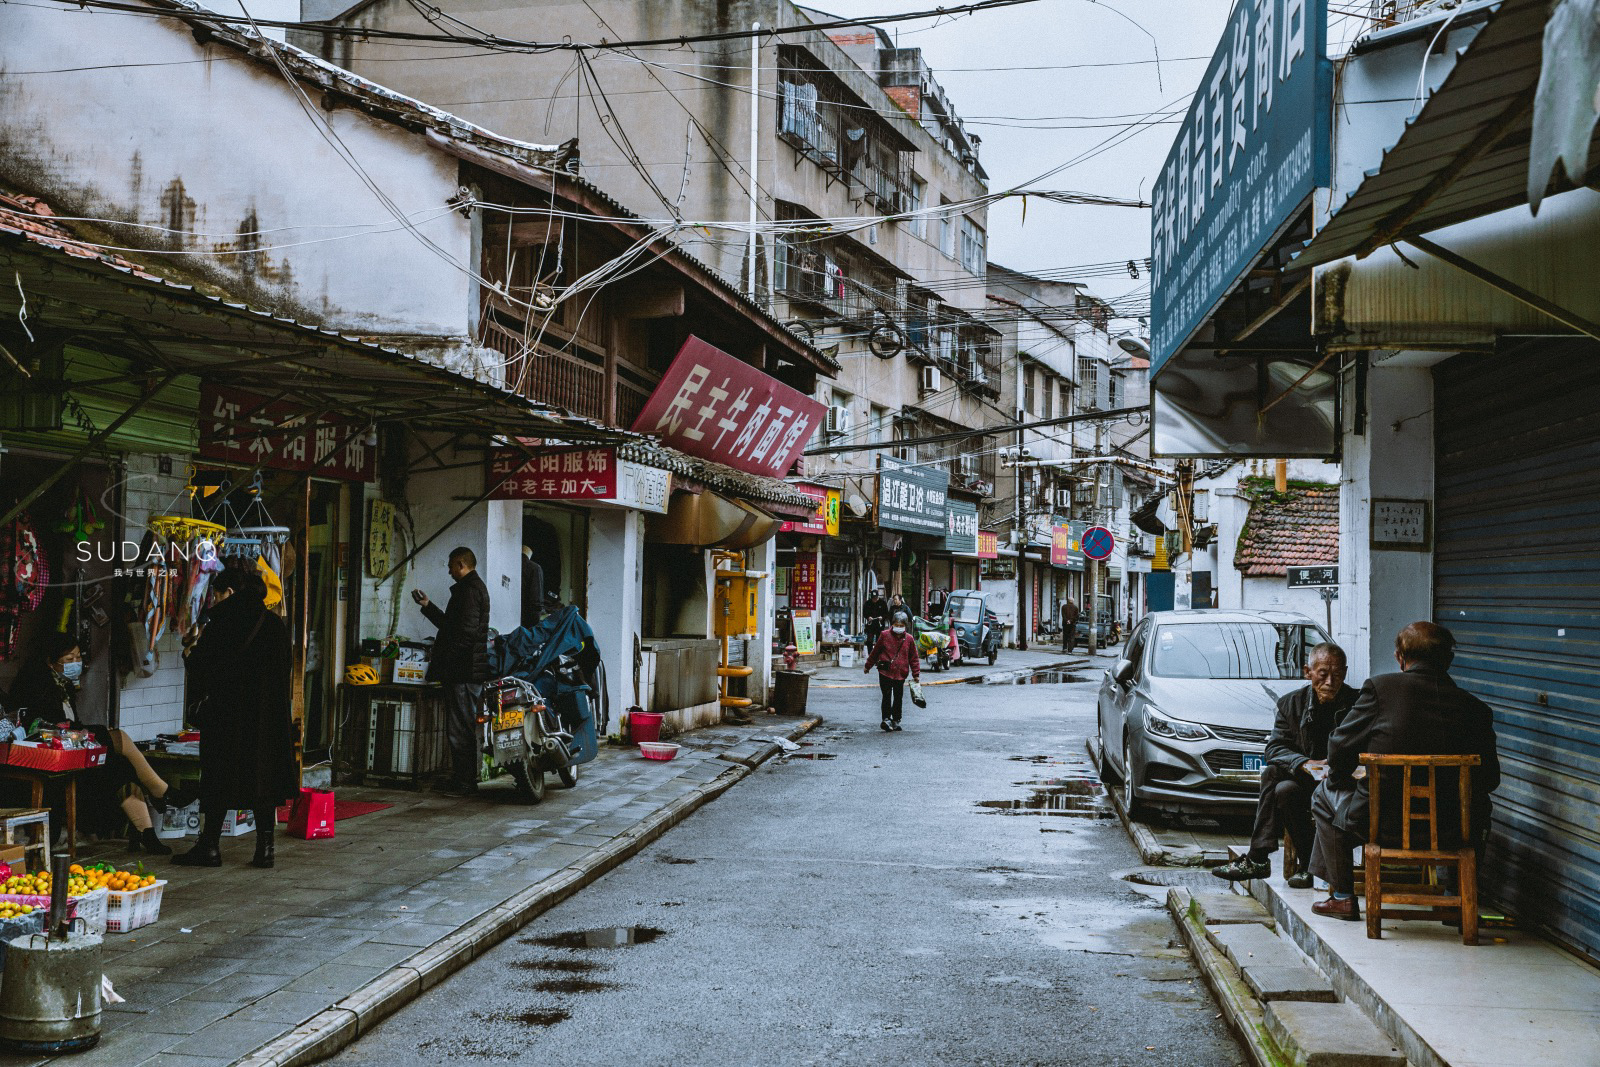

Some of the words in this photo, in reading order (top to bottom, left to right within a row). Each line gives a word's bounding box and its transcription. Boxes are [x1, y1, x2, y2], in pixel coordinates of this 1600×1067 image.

[1246, 142, 1268, 192] store
[655, 363, 809, 470] 民主牛肉面馆
[502, 478, 596, 495] 中老年加大
[497, 739, 523, 750] SUZUKI
